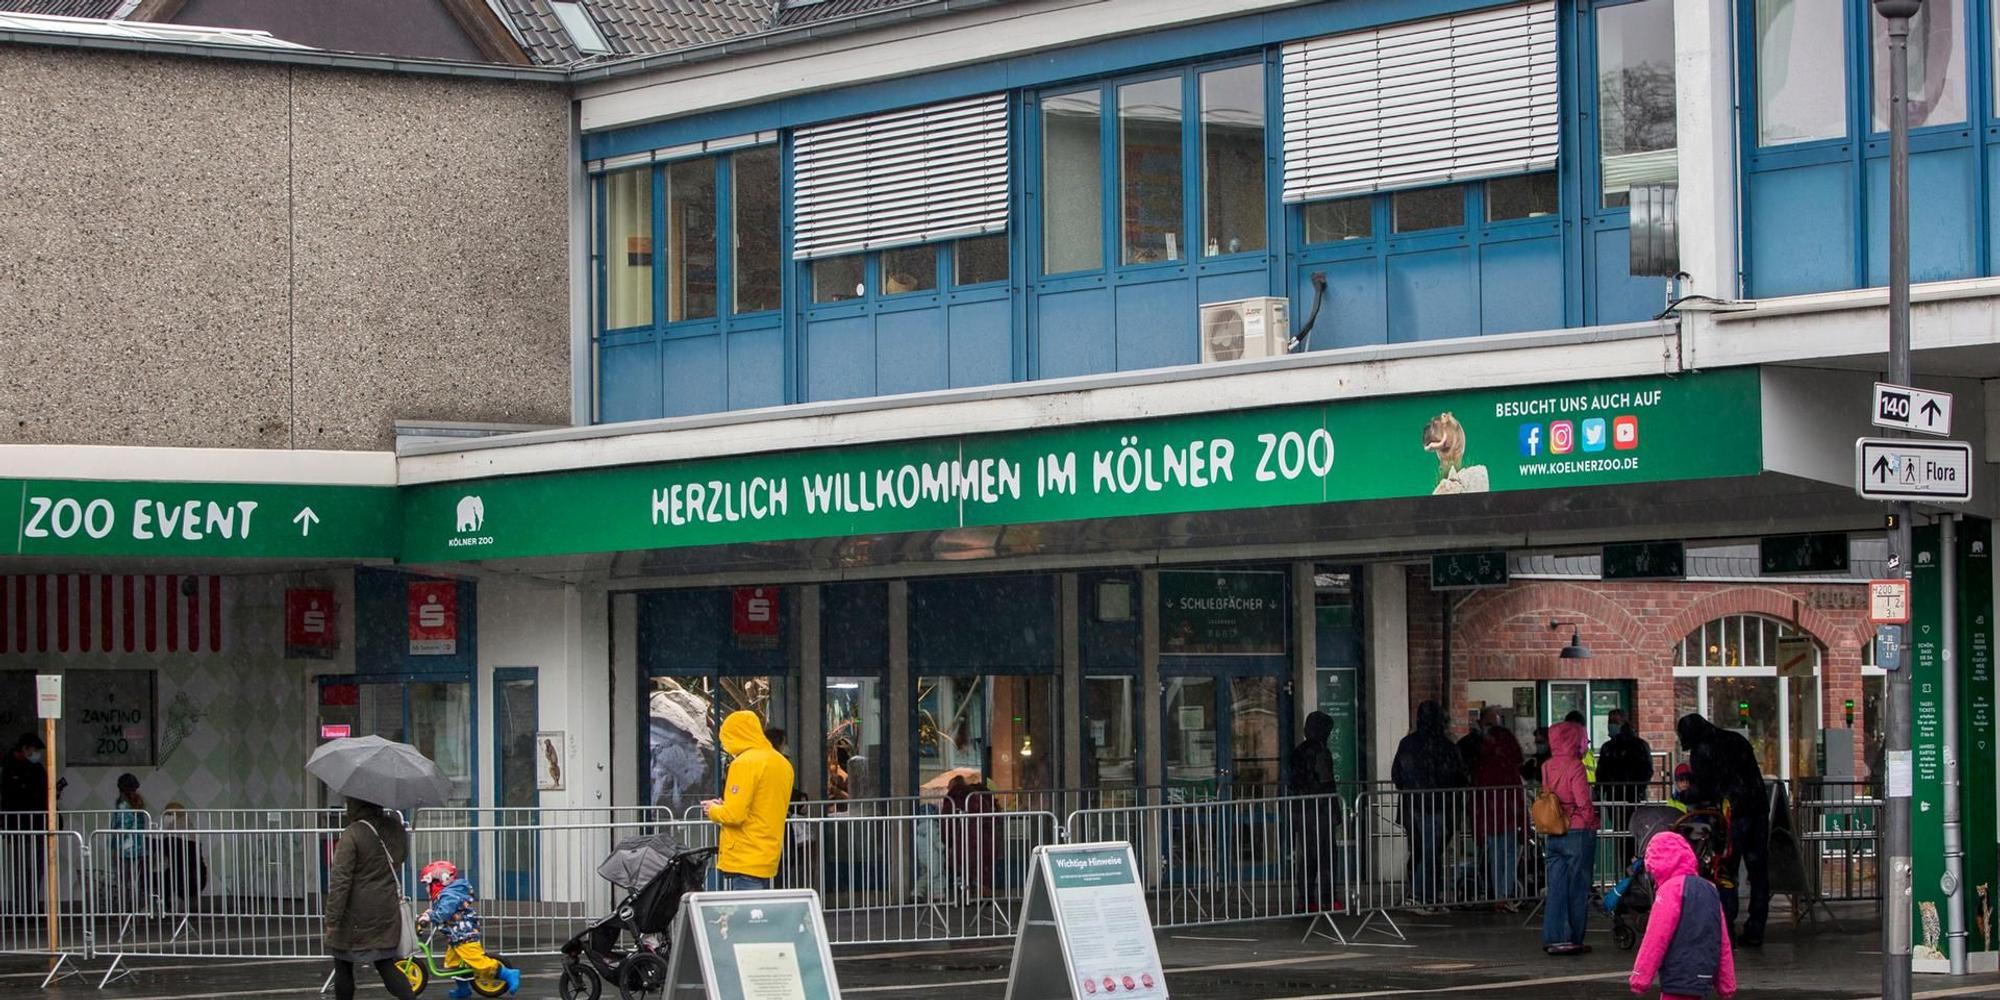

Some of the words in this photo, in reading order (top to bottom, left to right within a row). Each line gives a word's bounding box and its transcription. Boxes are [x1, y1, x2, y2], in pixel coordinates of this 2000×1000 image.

[1496, 399, 1557, 417] BESUCHT
[1560, 396, 1588, 412] UNS
[1591, 393, 1630, 410] AUCH
[1634, 390, 1662, 407] AUF
[1881, 396, 1909, 418] 140
[651, 476, 788, 526] HERZLICH
[802, 457, 1020, 515] WILLKOMMEN
[1038, 451, 1076, 498] IM
[1093, 435, 1235, 495] KÖLNER
[1255, 427, 1335, 482] ZOO
[1519, 457, 1639, 476] WWW.KOELNERZOO.DE
[1926, 461, 1956, 481] Flora
[24, 497, 116, 539] ZOO
[132, 499, 258, 540] EVENT
[448, 537, 477, 547] KÖLNER
[478, 536, 494, 545] ZOO
[1056, 857, 1088, 870] Wichtige
[1088, 855, 1122, 867] Hinweise
